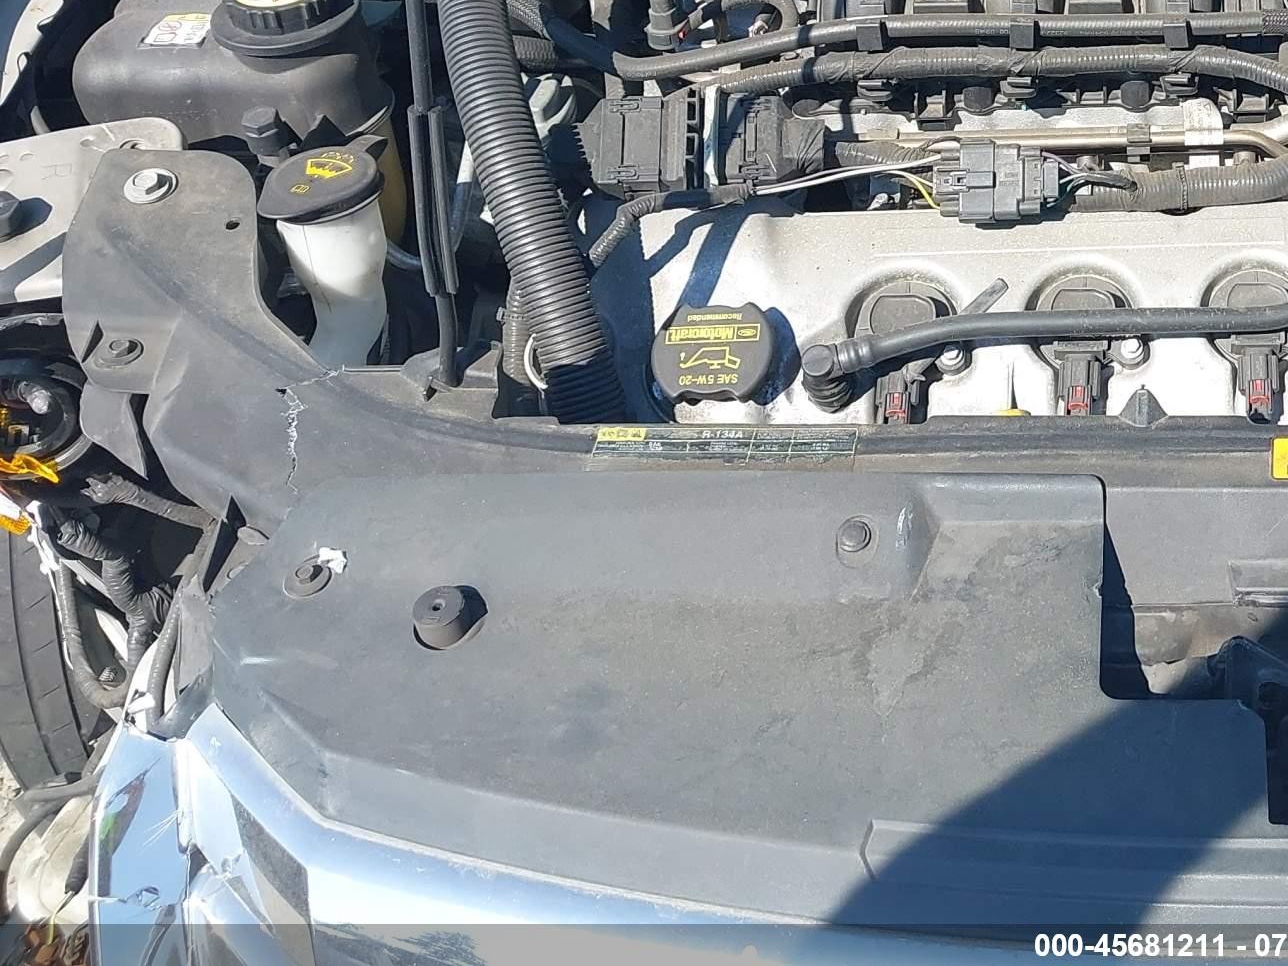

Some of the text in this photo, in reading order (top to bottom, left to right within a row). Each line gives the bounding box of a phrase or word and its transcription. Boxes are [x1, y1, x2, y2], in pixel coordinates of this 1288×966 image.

[687, 313, 743, 322] Recommended
[670, 326, 734, 341] Motorcraft
[678, 373, 739, 386] SAE 5W-20
[702, 430, 743, 439] R-134A
